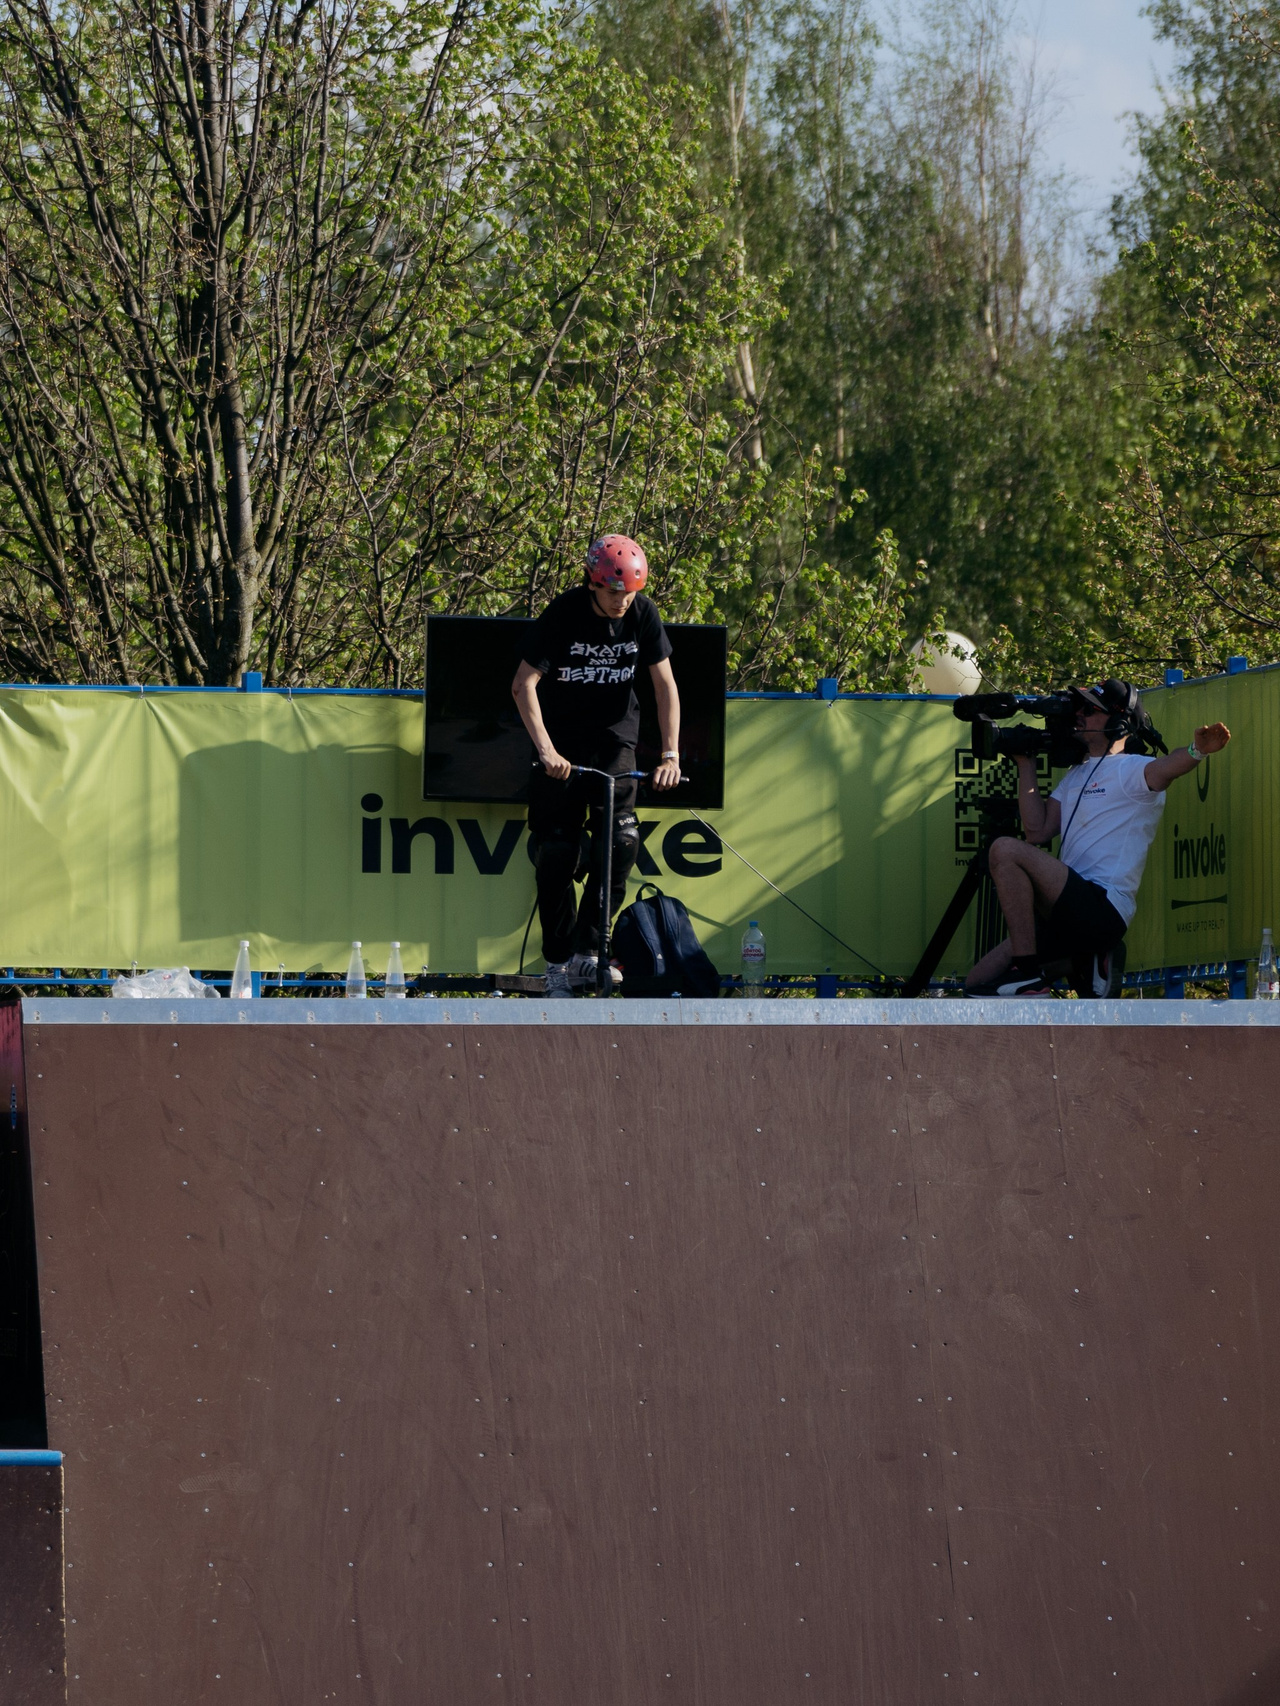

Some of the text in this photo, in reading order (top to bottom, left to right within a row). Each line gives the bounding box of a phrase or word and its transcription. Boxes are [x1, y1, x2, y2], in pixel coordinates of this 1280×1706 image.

[570, 641, 638, 657] SKATE
[1083, 787, 1106, 795] invoke
[1173, 823, 1226, 879] invoke
